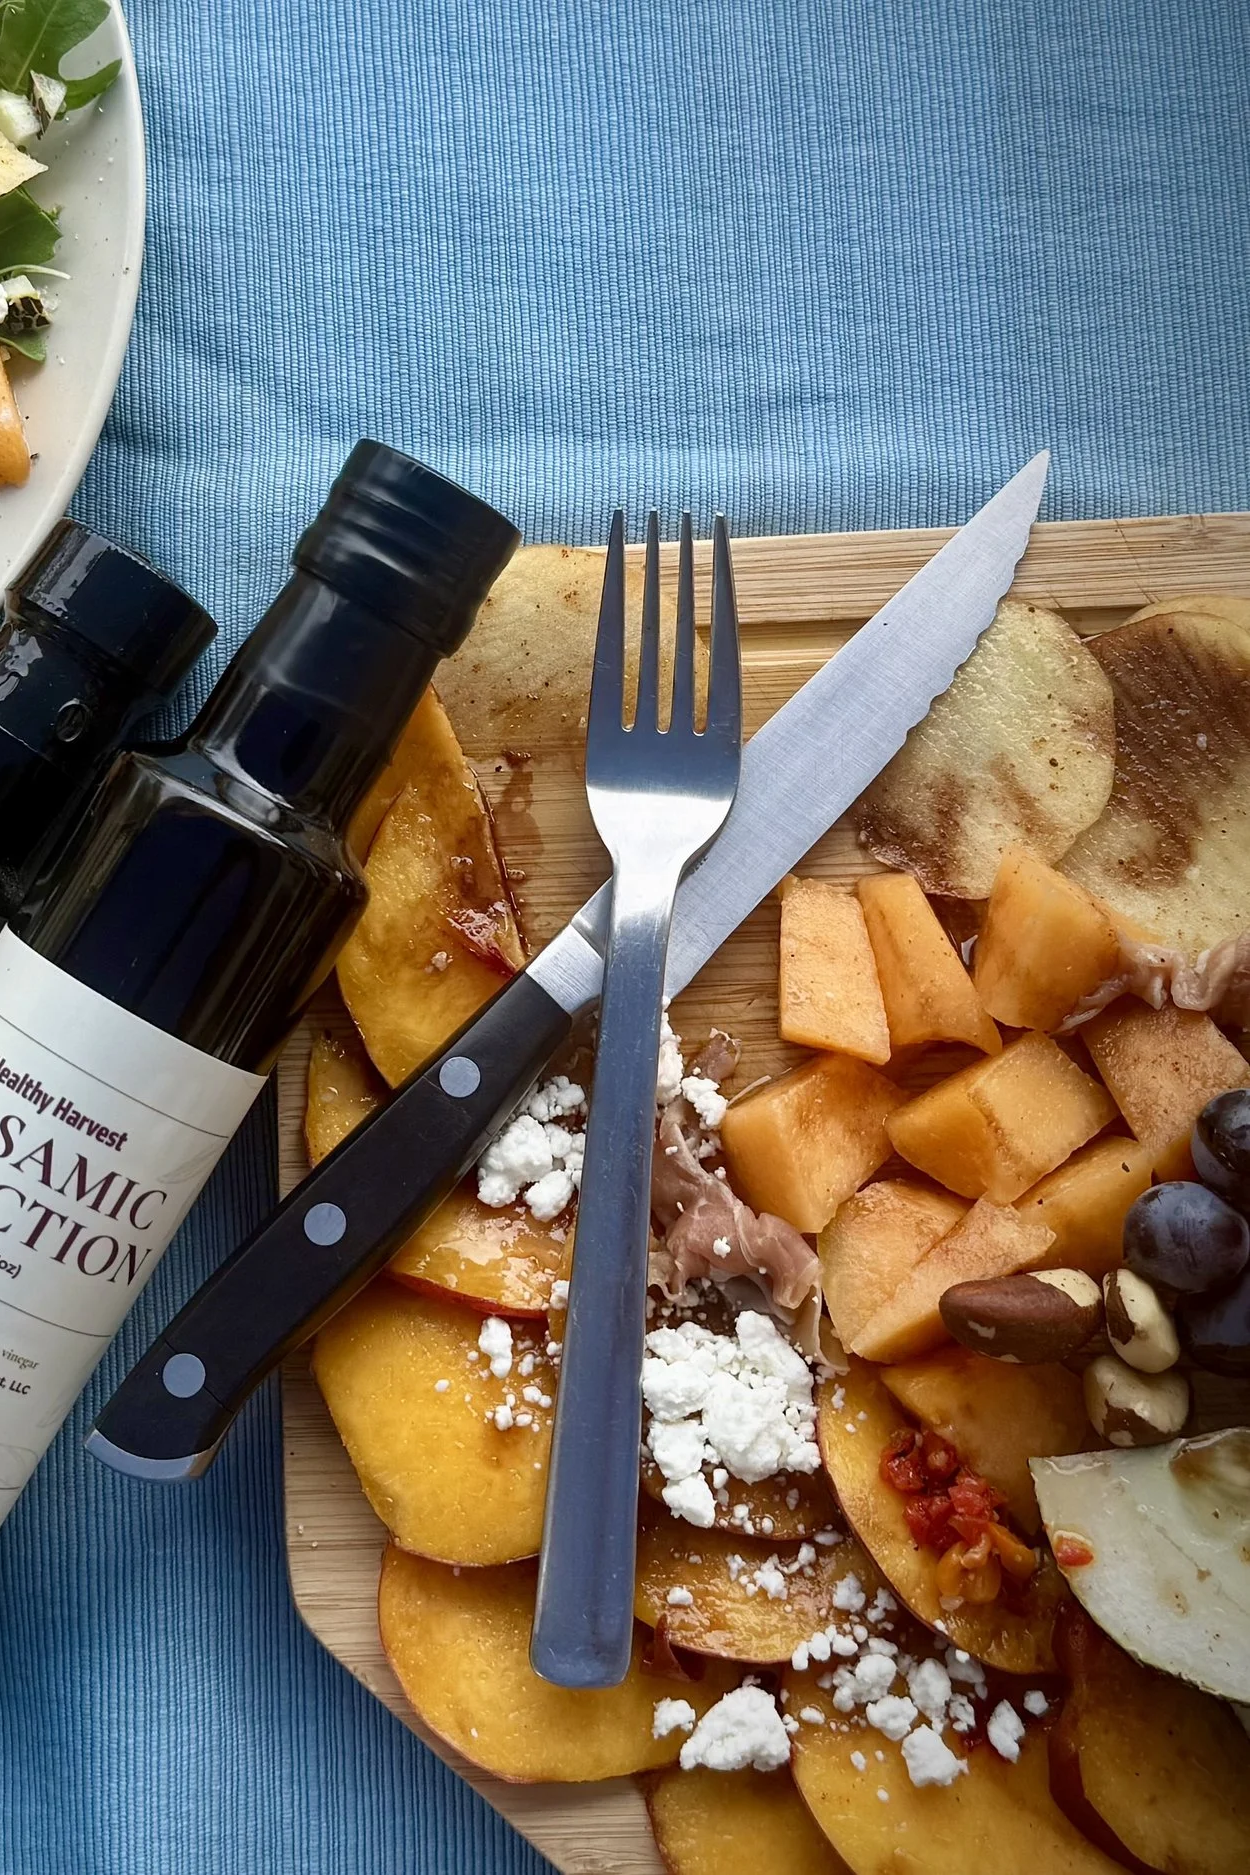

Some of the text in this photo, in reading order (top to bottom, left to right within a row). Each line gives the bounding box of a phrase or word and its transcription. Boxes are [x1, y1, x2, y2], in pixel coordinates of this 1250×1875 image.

[51, 1096, 128, 1152] Harvest
[1, 1348, 40, 1370] vinegar
[8, 1379, 32, 1395] LLC
